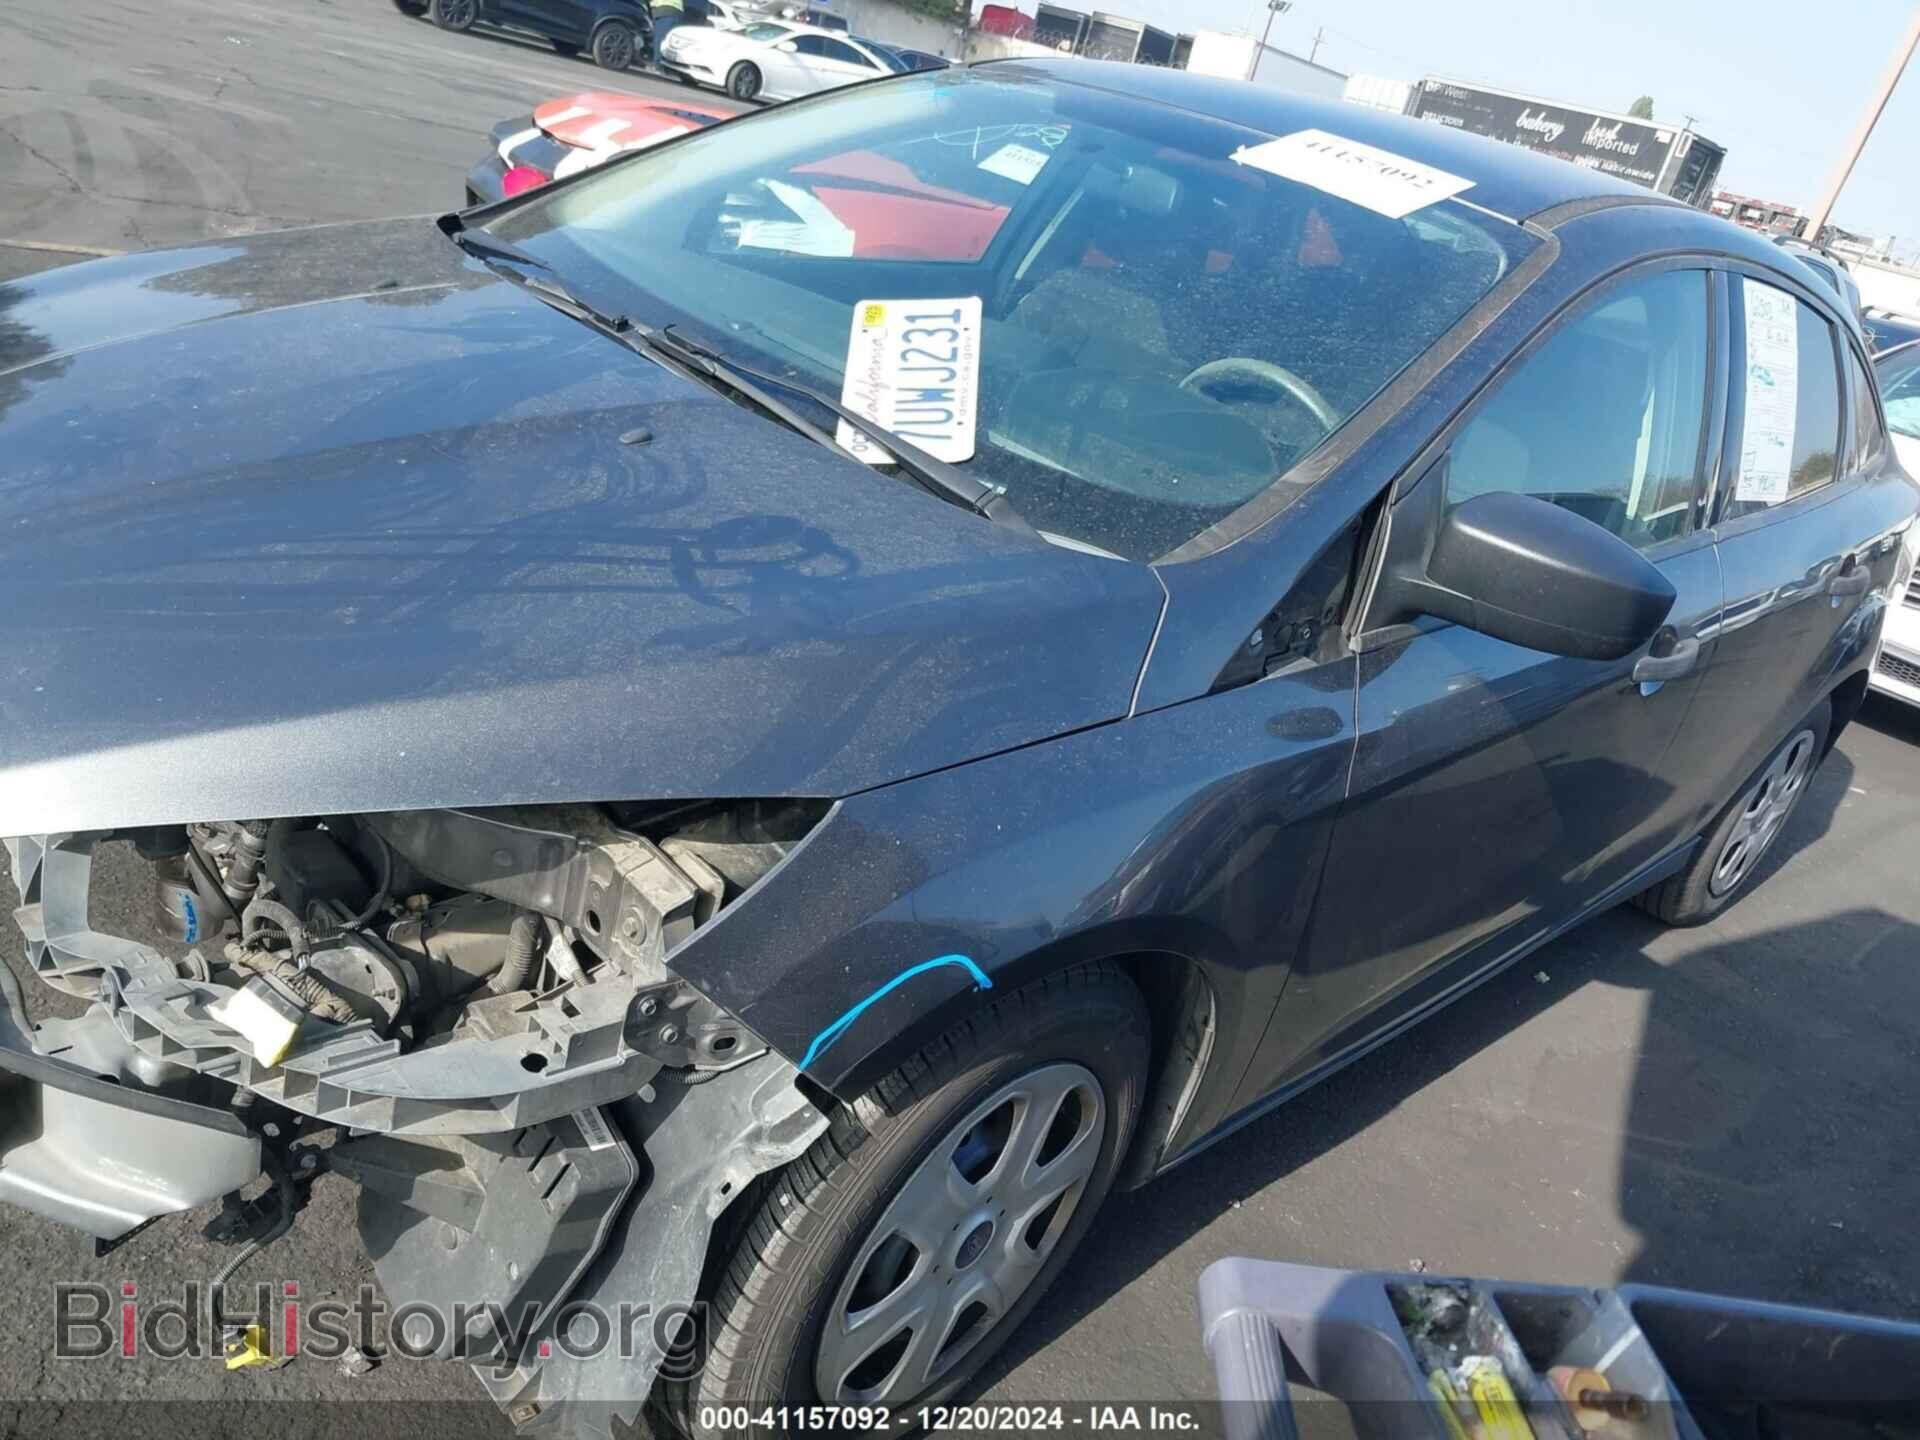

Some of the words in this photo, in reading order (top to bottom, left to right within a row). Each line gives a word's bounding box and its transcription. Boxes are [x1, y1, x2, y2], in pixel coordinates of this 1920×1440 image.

[1516, 108, 1565, 142] bakery
[1582, 130, 1639, 156] imported
[891, 308, 961, 440] 7UWJ231
